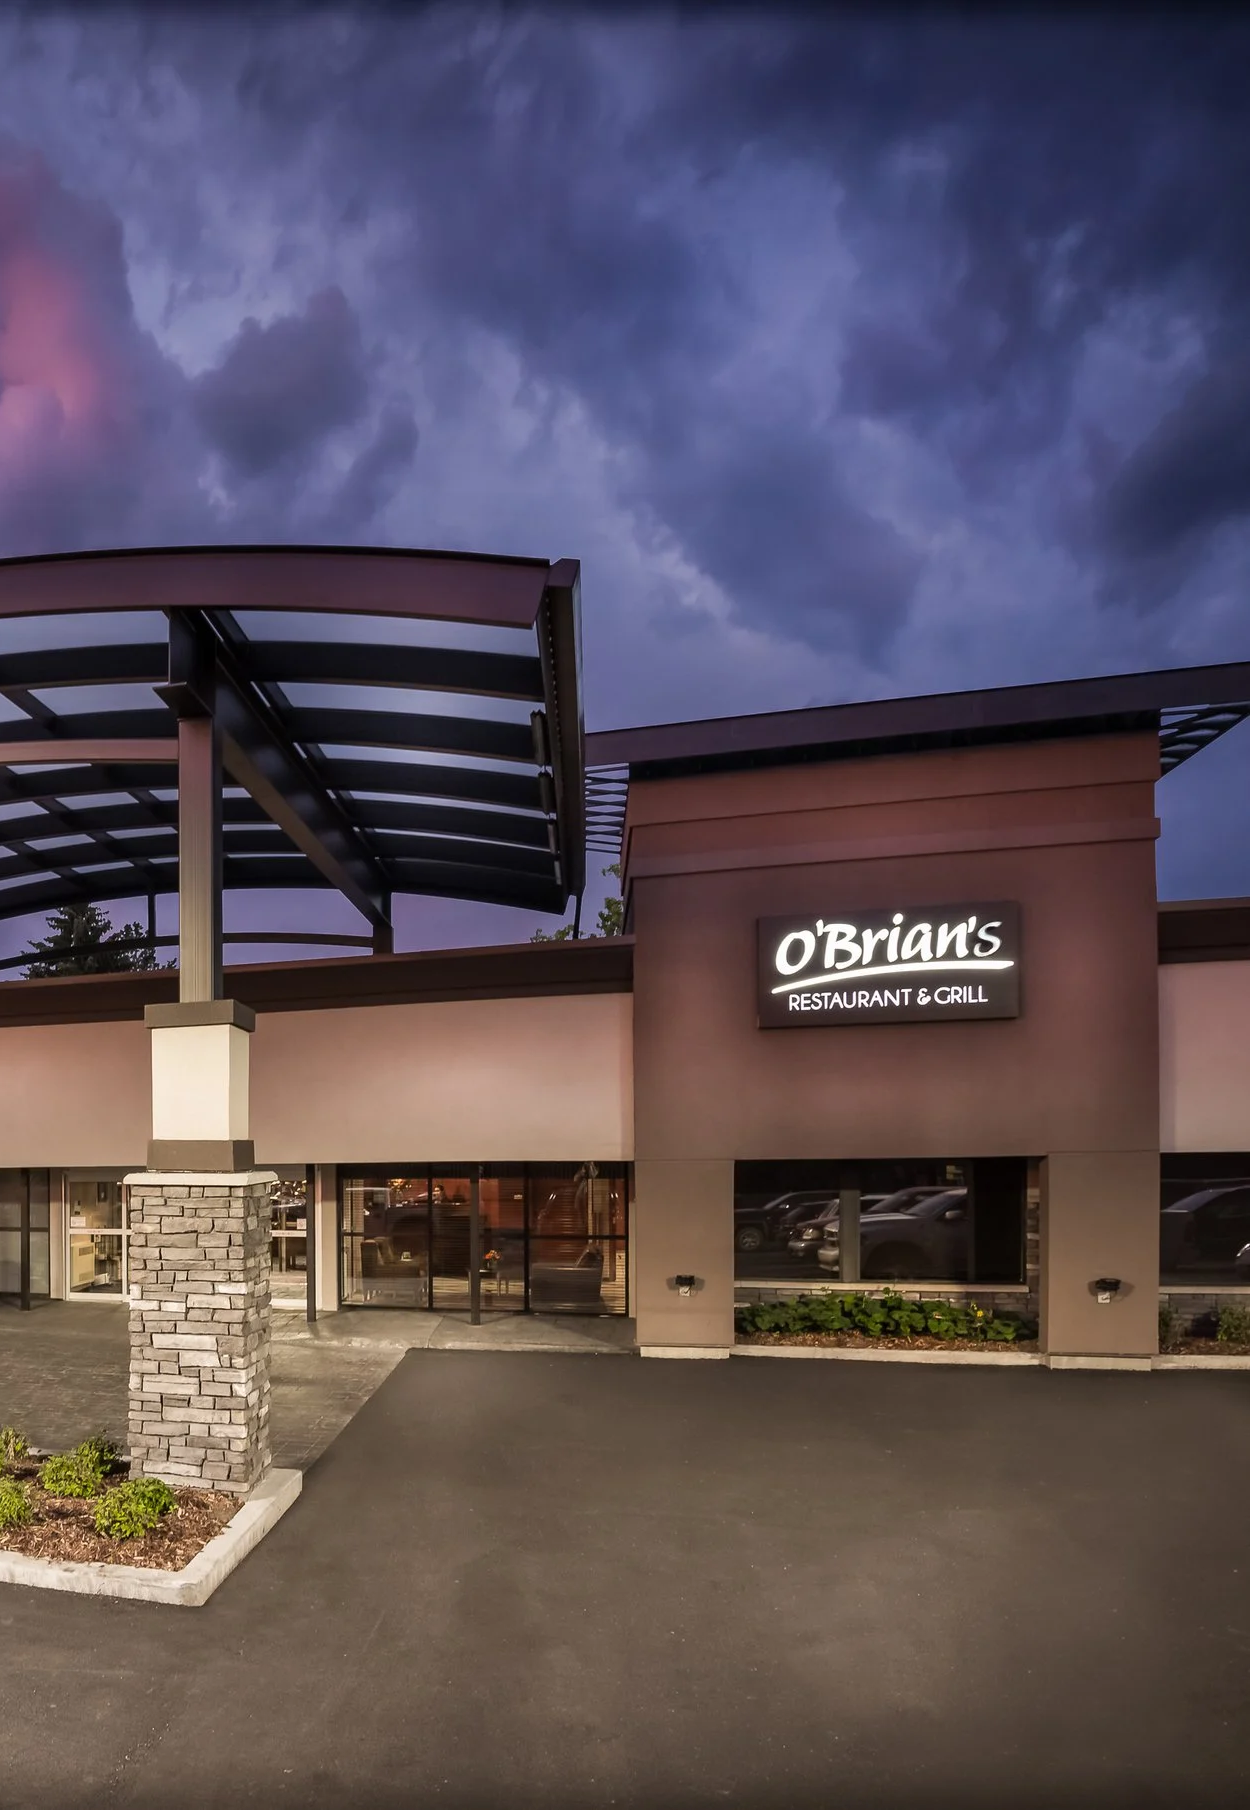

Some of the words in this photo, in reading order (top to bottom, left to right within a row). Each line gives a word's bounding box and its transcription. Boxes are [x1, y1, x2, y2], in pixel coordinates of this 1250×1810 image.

[774, 912, 1003, 976] O'Brian's
[788, 988, 912, 1011] RESTAURANT
[916, 987, 932, 1006] &
[933, 985, 989, 1005] GRILL
